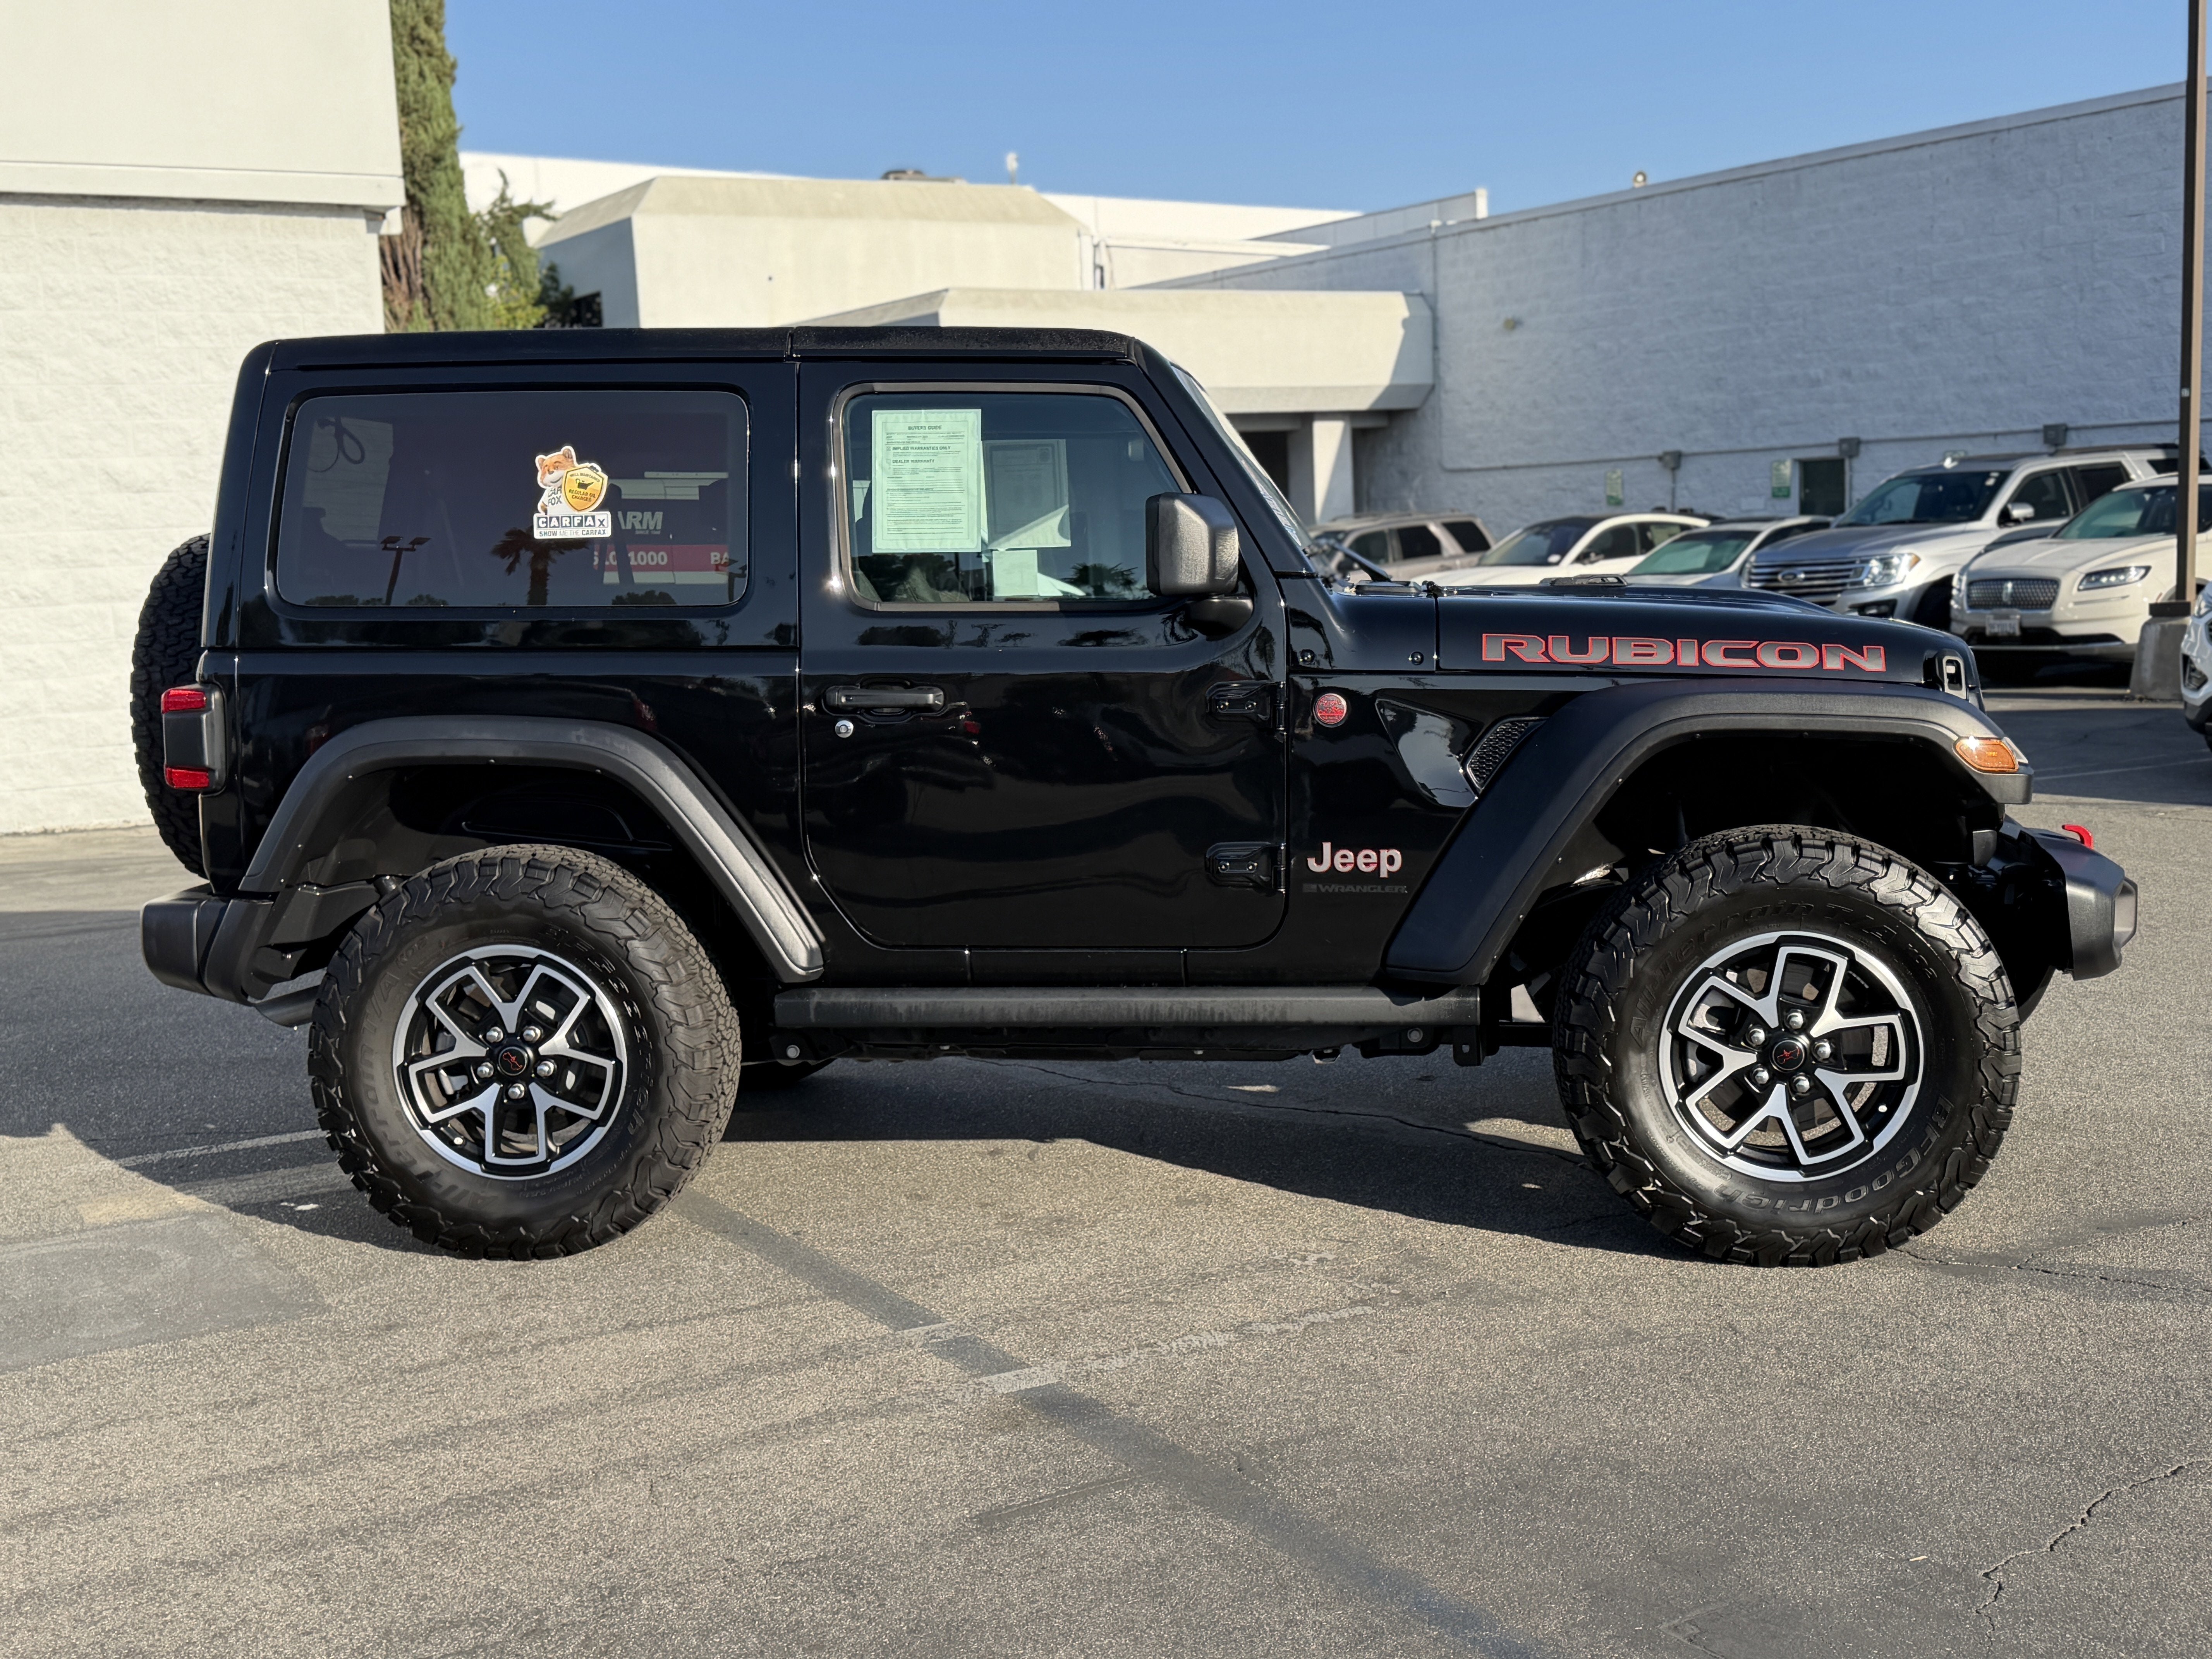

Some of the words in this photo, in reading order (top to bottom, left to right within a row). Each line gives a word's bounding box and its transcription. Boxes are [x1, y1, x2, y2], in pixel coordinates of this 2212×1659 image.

[548, 488, 562, 498] CAR
[548, 496, 562, 505] FOX
[538, 515, 605, 528] CARFAX
[628, 551, 668, 565] 1000
[1482, 633, 1886, 672] RUBICON
[1307, 842, 1402, 878] Jeep
[1317, 884, 1407, 893] WRANGLER
[1714, 1094, 1955, 1214] BFGoodrich
